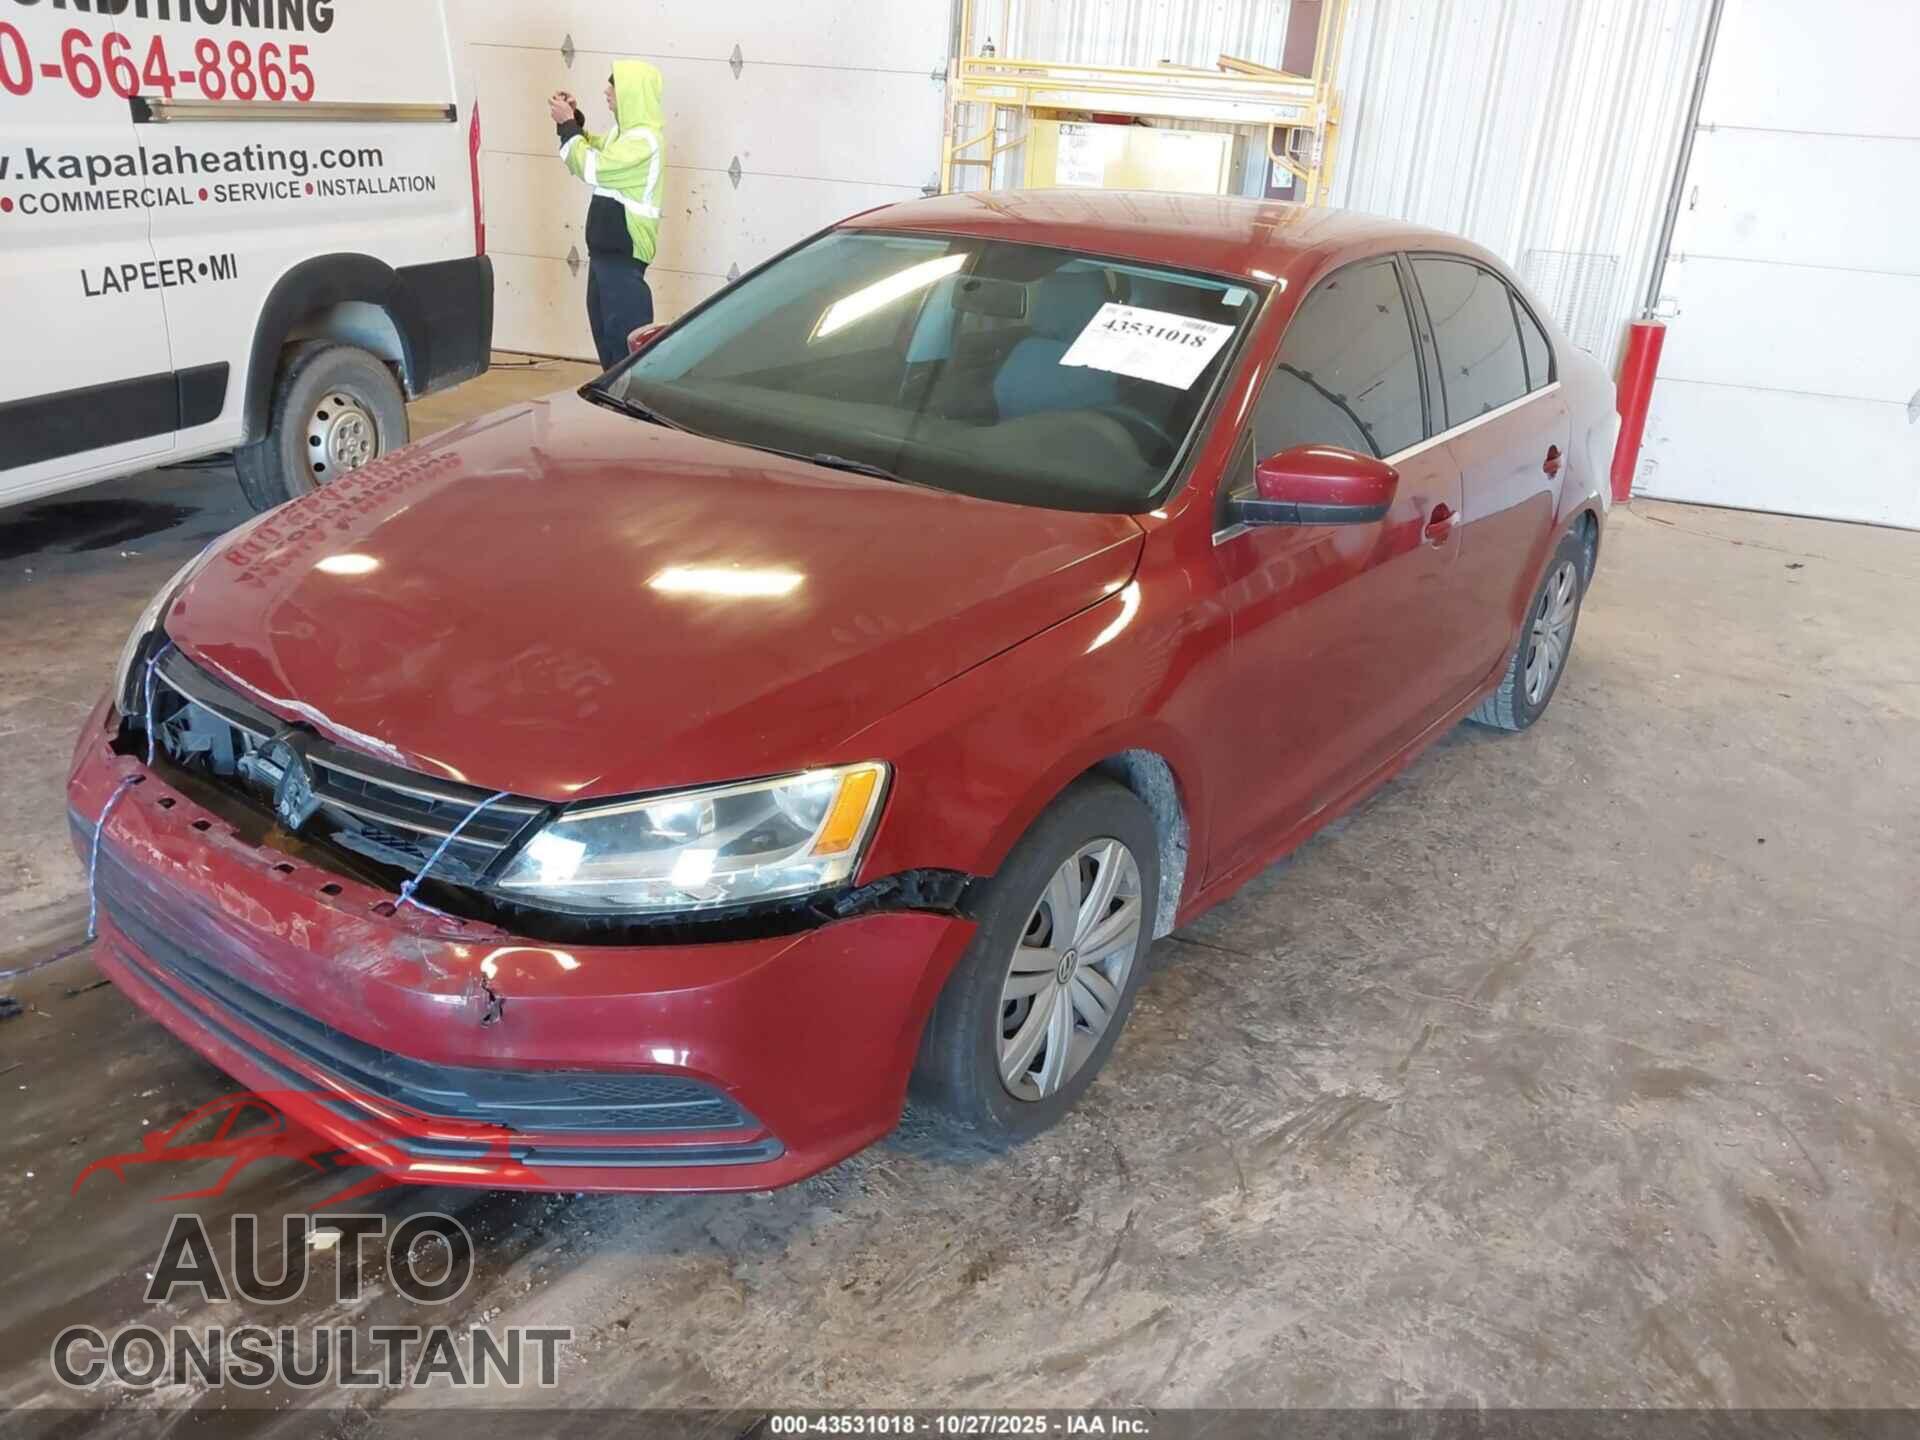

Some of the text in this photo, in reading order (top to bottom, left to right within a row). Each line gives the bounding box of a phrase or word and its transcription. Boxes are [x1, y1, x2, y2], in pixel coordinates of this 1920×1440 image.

[19, 176, 436, 214] COMMERCIAL SERVICE INSTALLATION
[1102, 318, 1208, 348] 43531018
